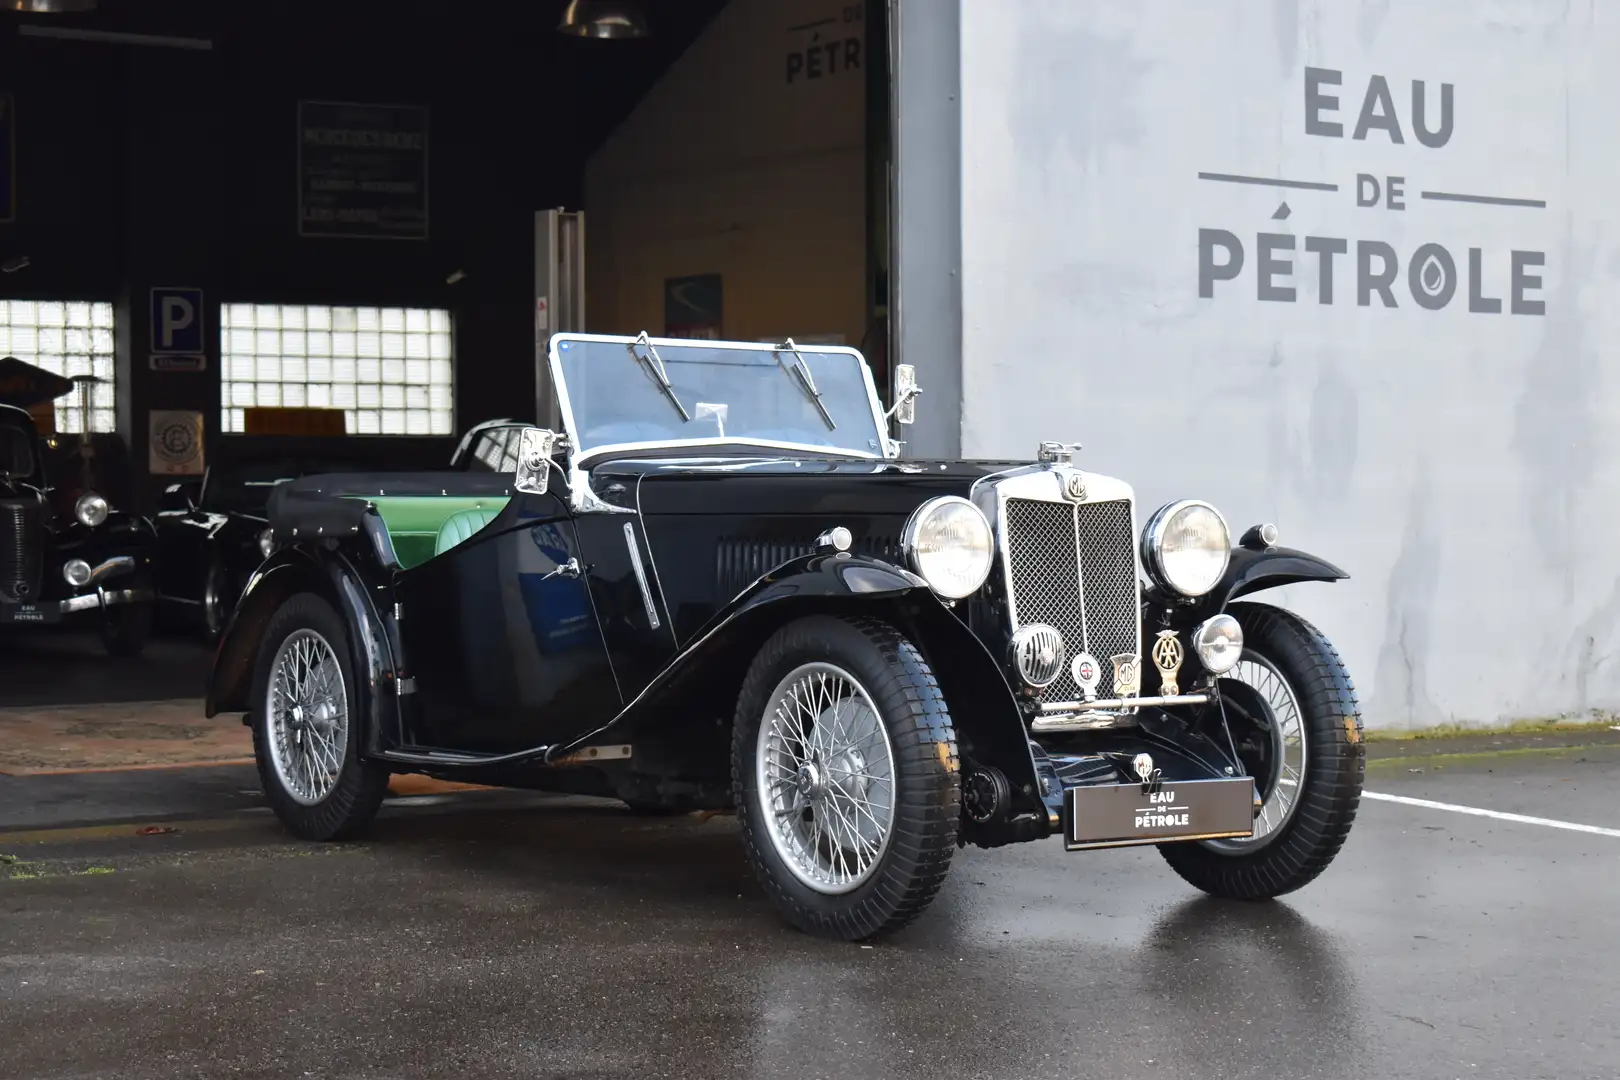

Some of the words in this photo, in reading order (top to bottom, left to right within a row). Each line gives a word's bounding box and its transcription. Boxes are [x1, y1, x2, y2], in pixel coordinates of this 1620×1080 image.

[1304, 66, 1454, 149] EAU
[1356, 173, 1406, 211] DE
[1198, 201, 1546, 316] PÉTROLE
[161, 295, 194, 347] P
[1121, 665, 1133, 682] MG
[1150, 791, 1175, 803] EAU
[1135, 811, 1189, 828] PÉTROLE
